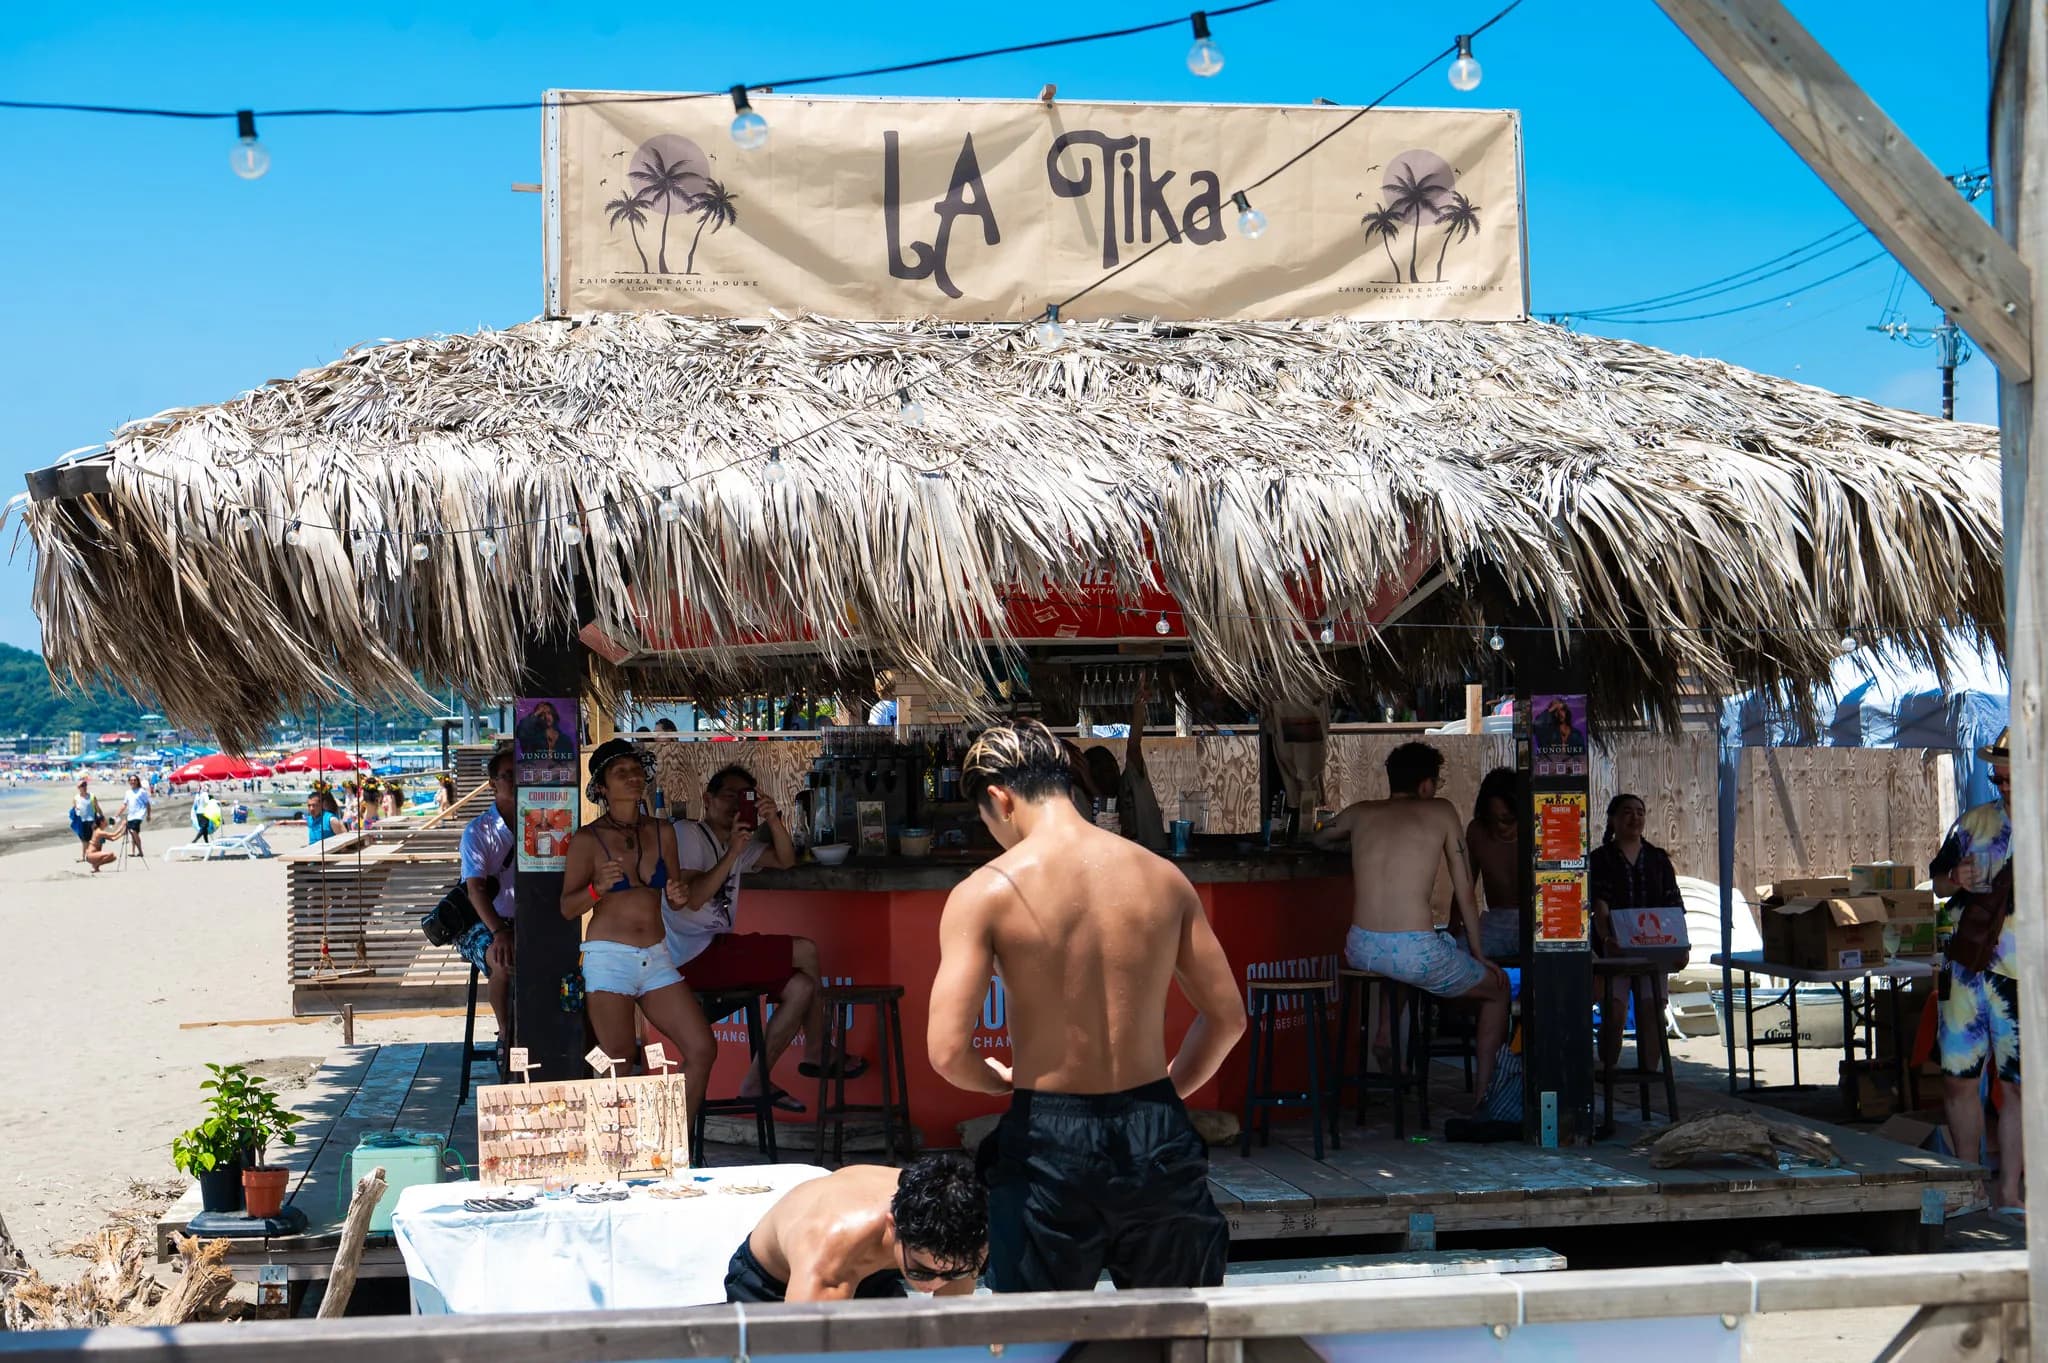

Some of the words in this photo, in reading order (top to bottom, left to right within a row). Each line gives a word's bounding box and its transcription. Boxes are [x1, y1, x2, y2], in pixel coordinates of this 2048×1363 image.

[884, 130, 1000, 299] LA
[1047, 130, 1227, 269] Tika
[520, 751, 573, 760] YUNOSUKE
[1764, 1028, 1812, 1041] Corna
